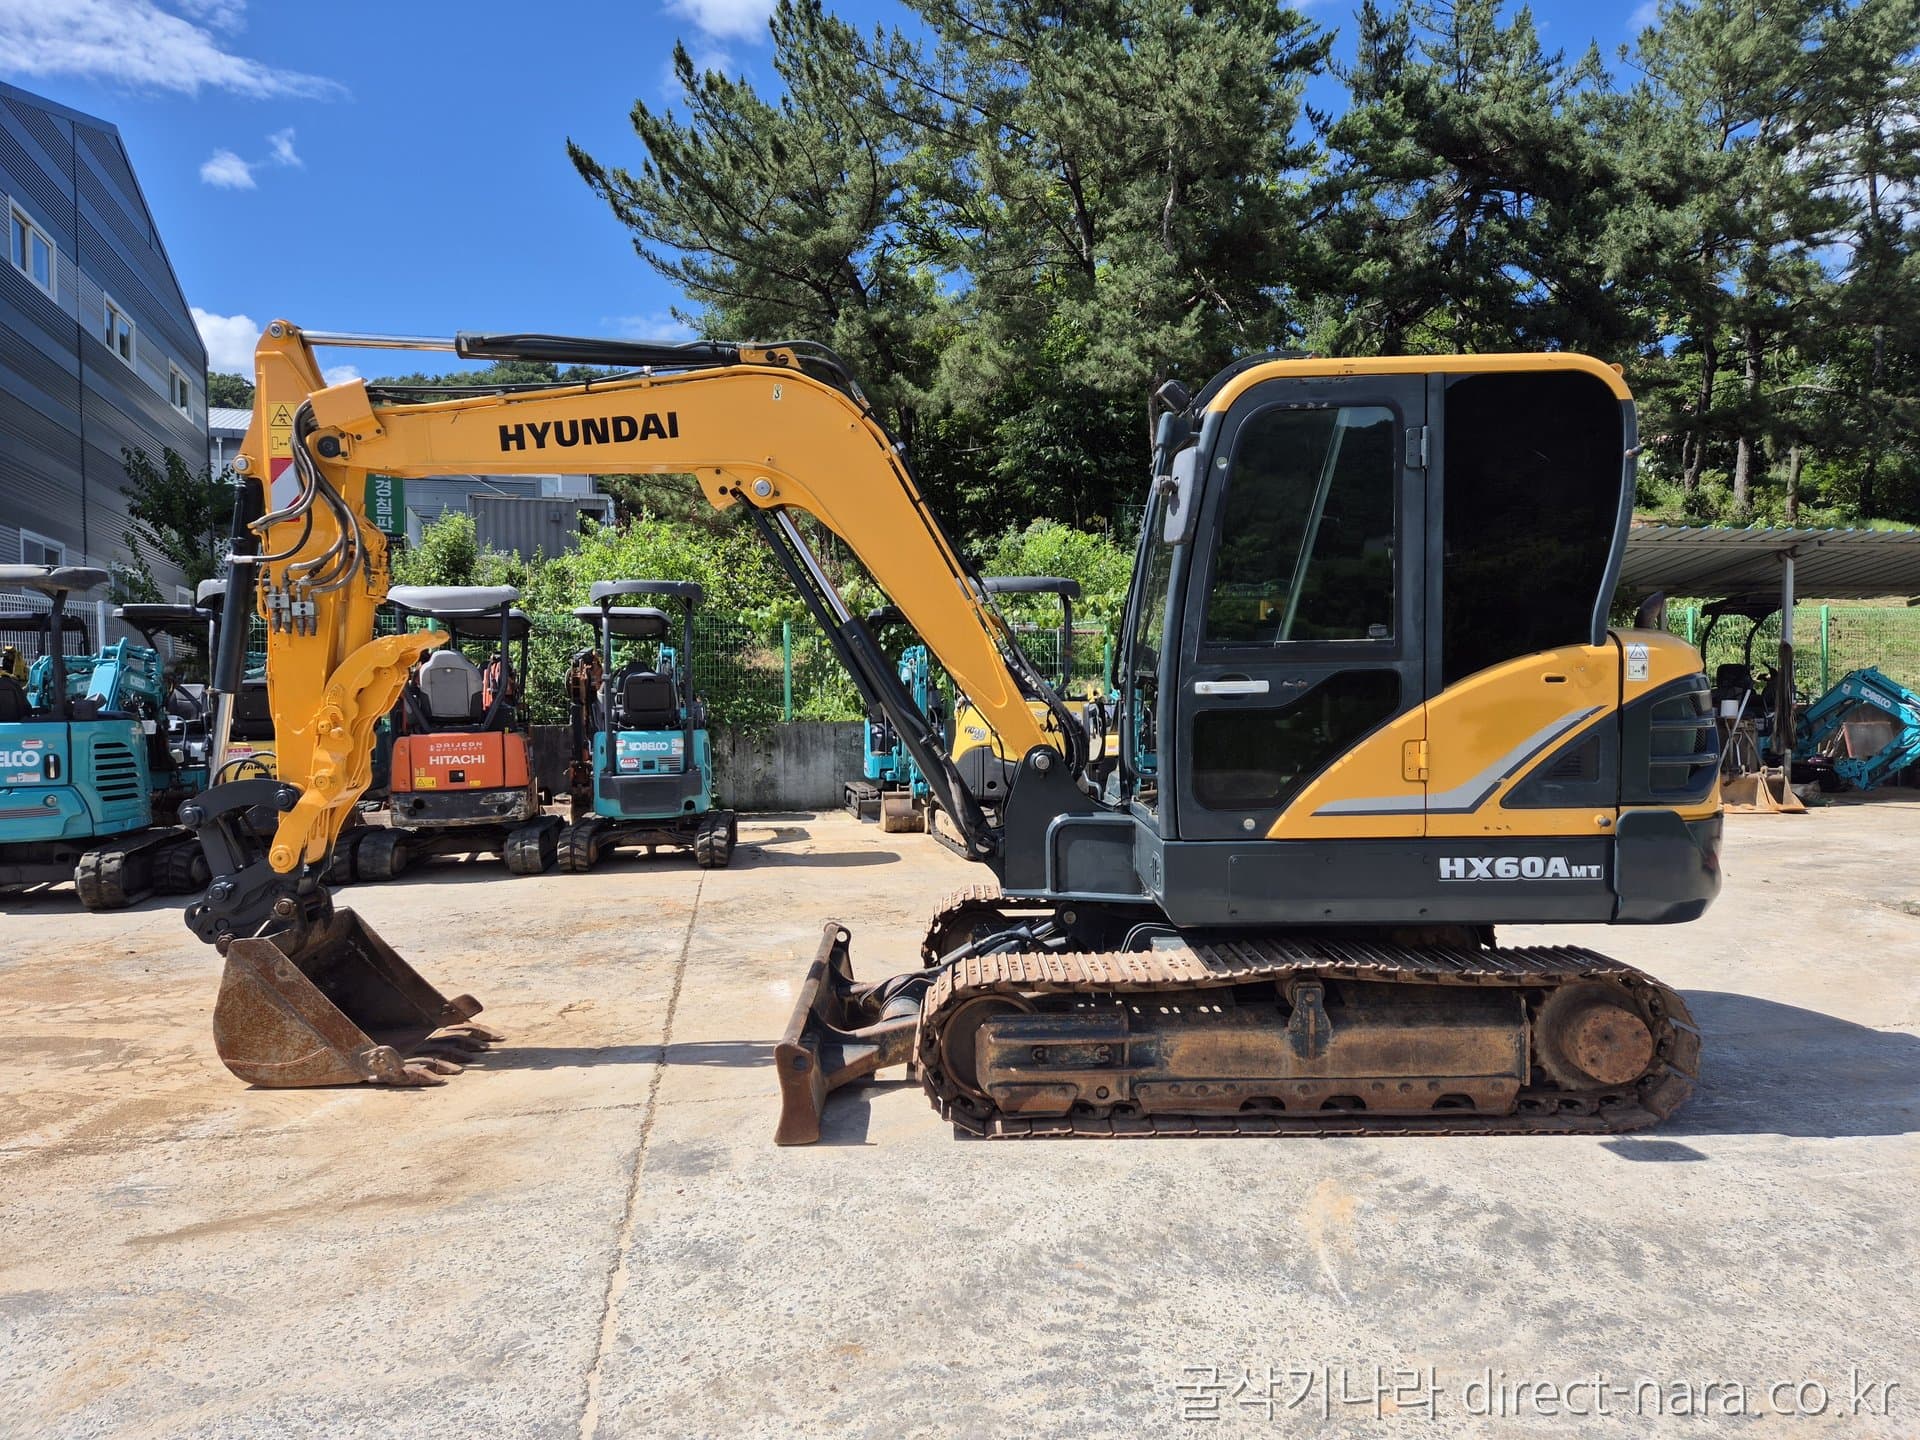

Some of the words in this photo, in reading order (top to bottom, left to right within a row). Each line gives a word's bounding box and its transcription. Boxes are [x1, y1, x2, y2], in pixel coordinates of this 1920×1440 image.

[499, 411, 679, 452] HYUNDAI
[375, 474, 395, 532] 경칠판
[1860, 686, 1892, 709] KOBELCO
[629, 741, 669, 751] KOBELCO
[429, 754, 485, 765] HITACHI
